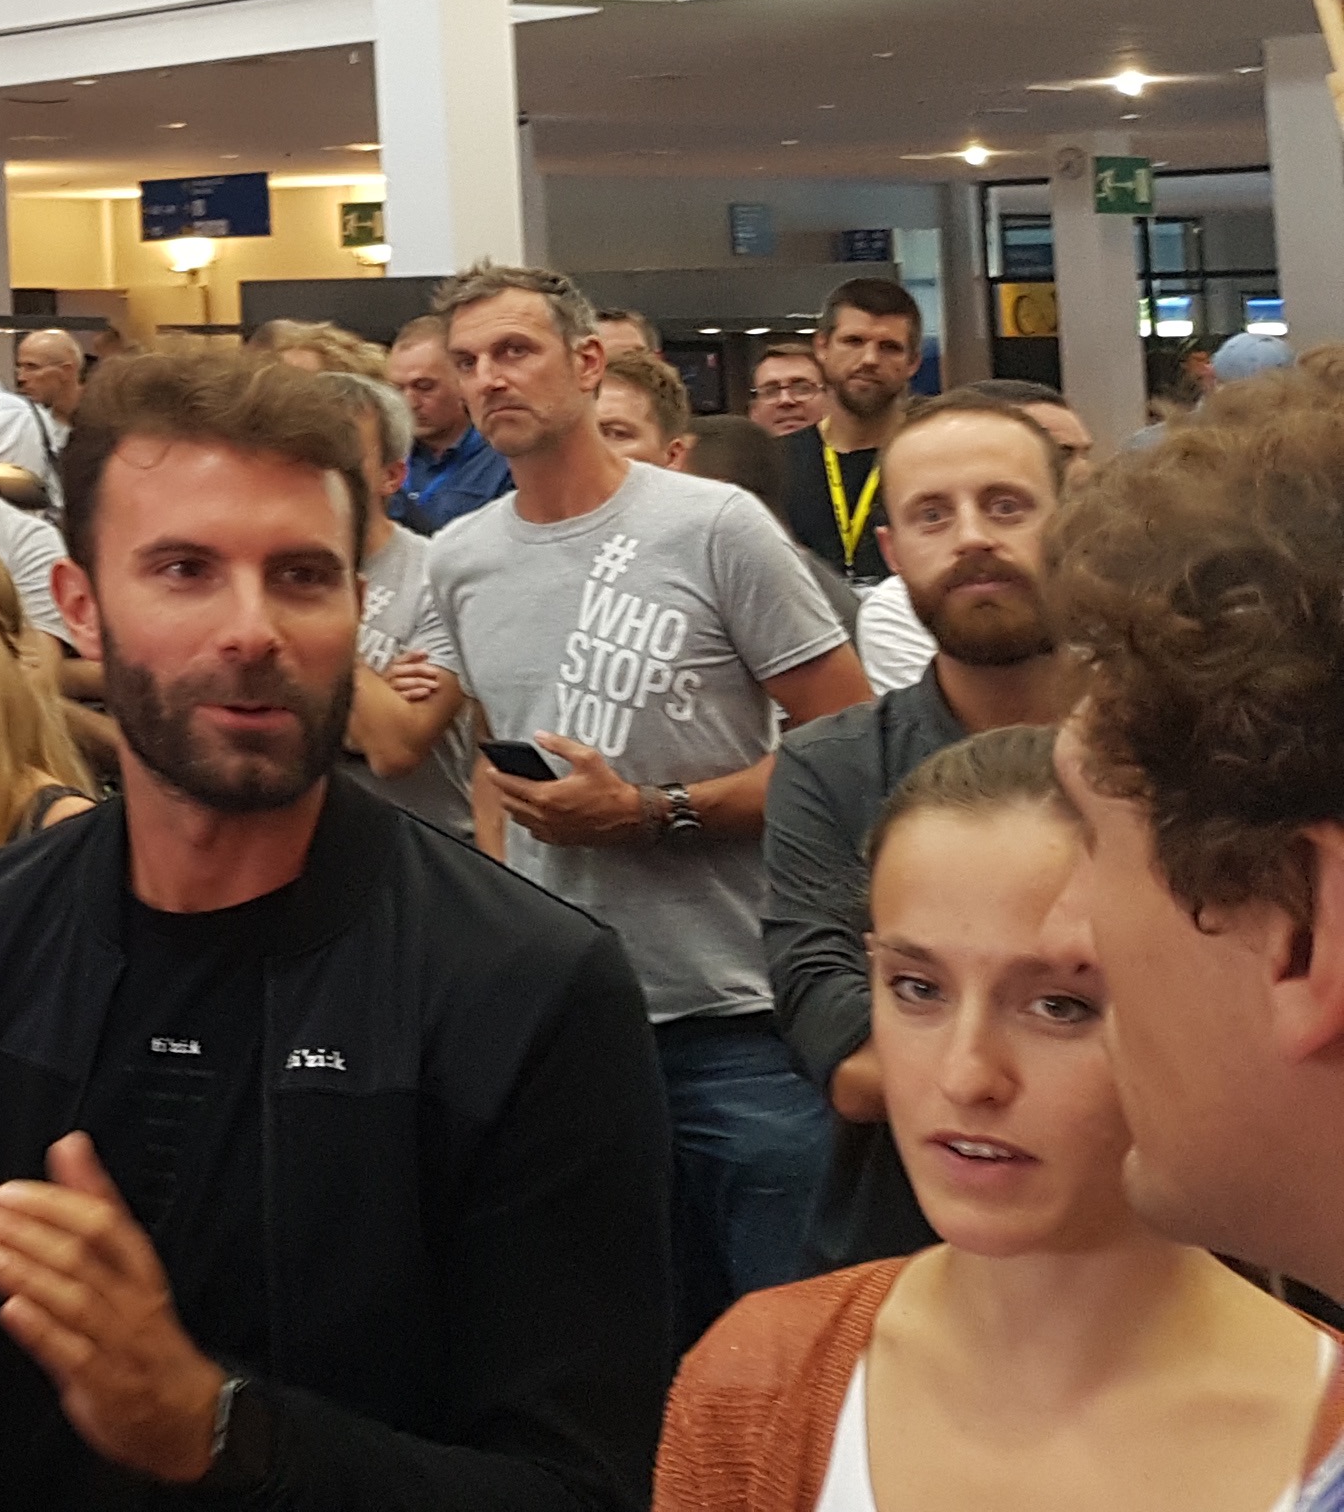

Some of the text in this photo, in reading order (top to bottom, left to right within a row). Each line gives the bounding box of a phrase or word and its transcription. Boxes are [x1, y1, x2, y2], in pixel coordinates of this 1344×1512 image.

[589, 534, 640, 582] #
[578, 579, 689, 661] WHO
[560, 631, 702, 722] STOPS
[556, 682, 634, 758] YOU
